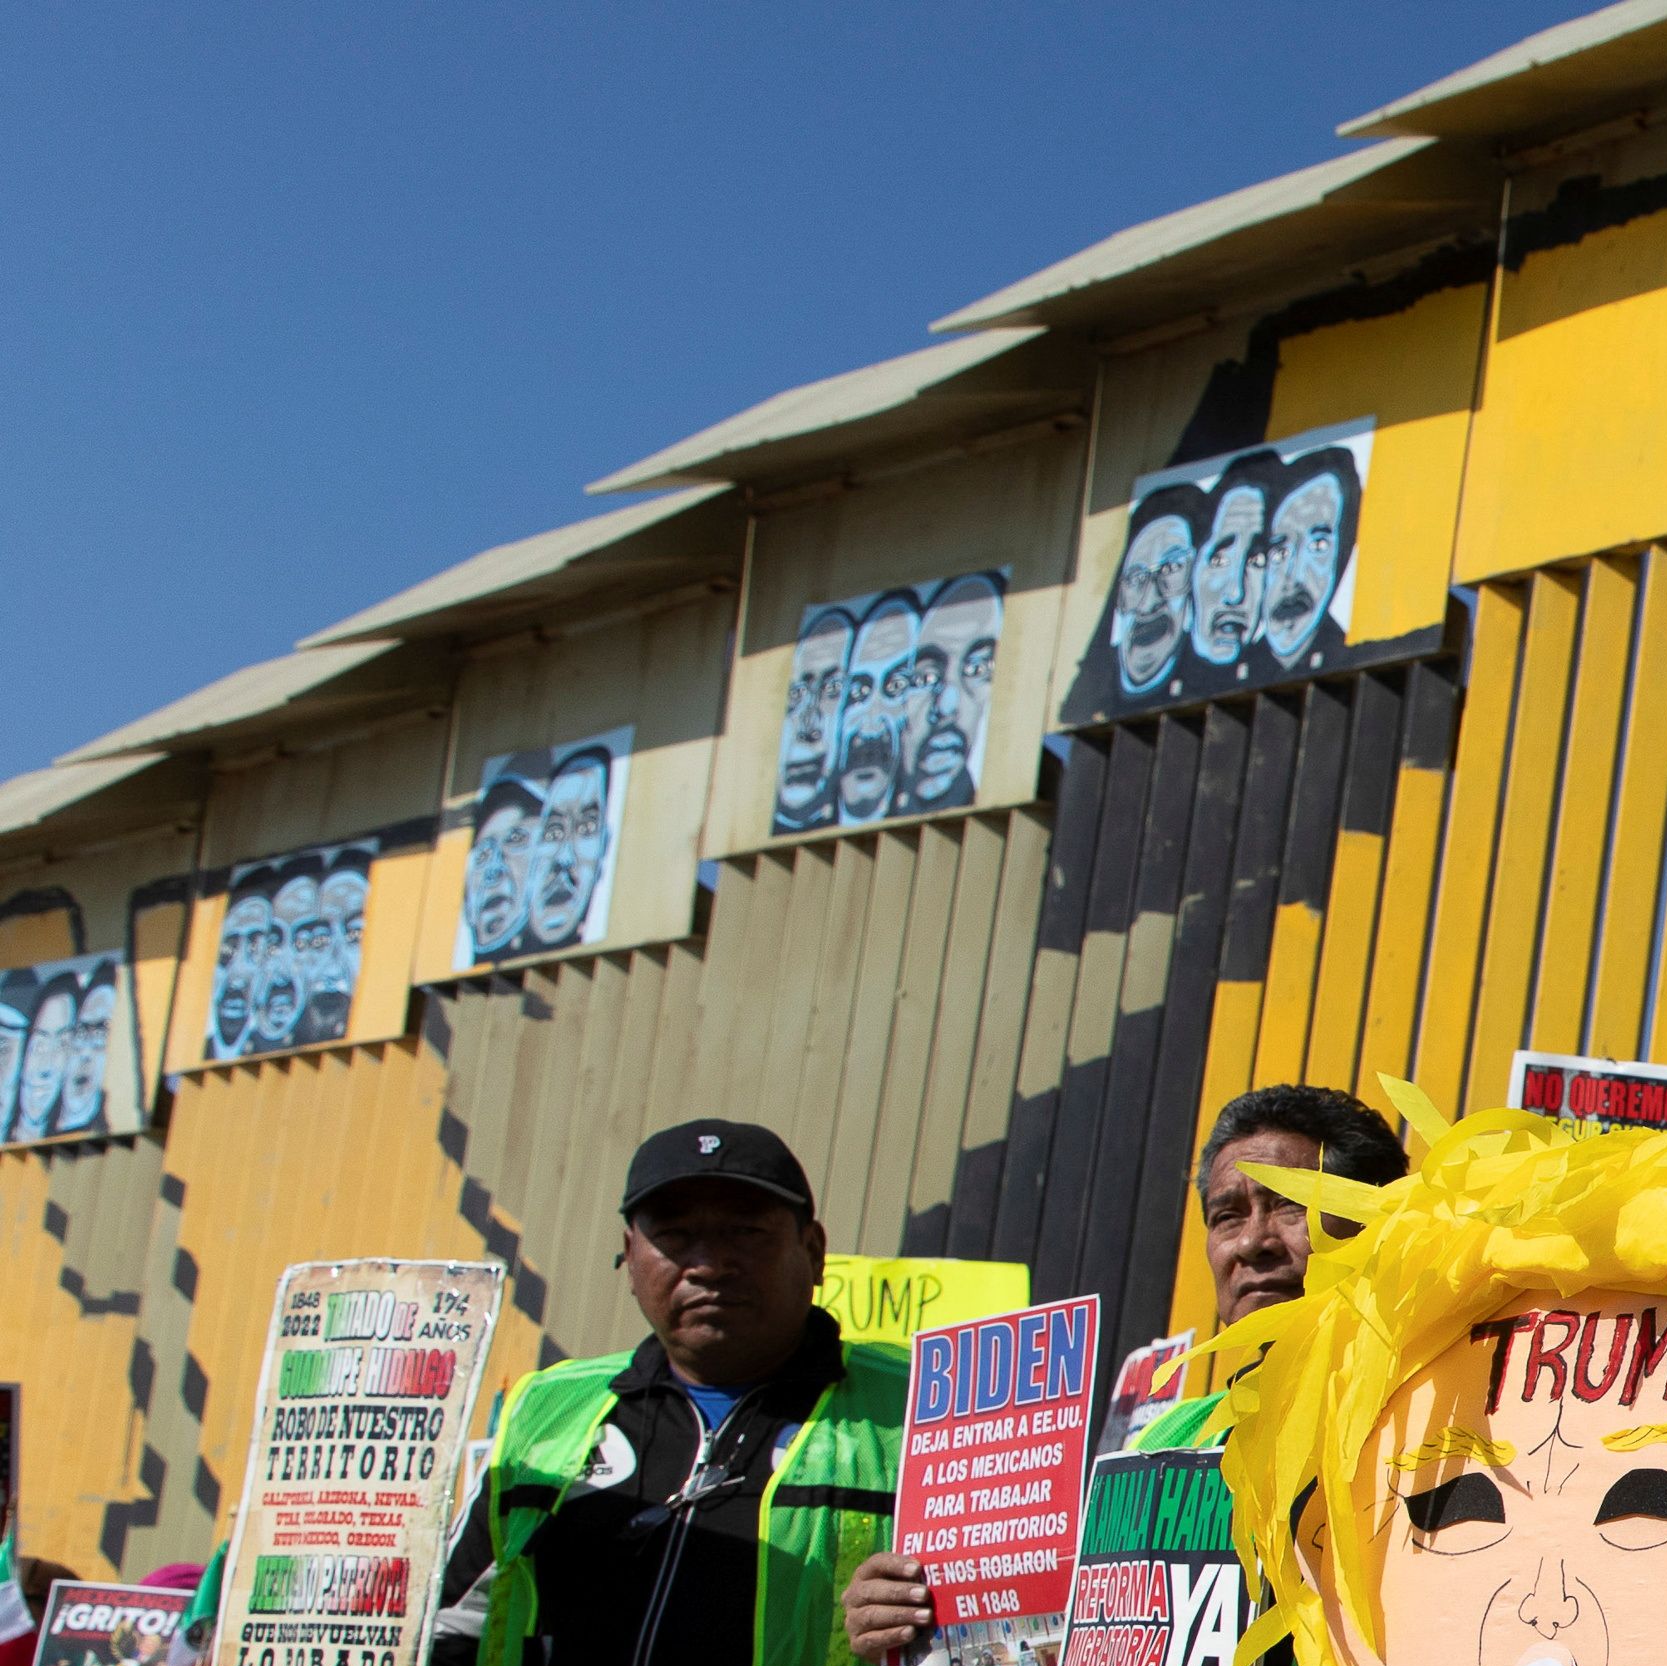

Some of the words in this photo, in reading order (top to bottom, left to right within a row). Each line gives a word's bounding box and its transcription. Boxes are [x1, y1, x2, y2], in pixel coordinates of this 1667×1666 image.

[1523, 1070, 1563, 1111] NO
[698, 1135, 721, 1154] P
[282, 1314, 321, 1337] 2022
[914, 1305, 1089, 1424] BIDEN
[339, 1406, 444, 1441] NUESTRO
[911, 1427, 949, 1455] DEJA
[953, 1415, 1014, 1449] ENTRAR
[1017, 1415, 1028, 1436] A
[1033, 1405, 1083, 1435] EE.UU.
[266, 1444, 437, 1482] TERRITORIO
[922, 1465, 933, 1486] A
[937, 1460, 968, 1484] LOS
[970, 1443, 1063, 1479] MEXICANOS
[924, 1493, 965, 1519] PARA
[970, 1479, 1052, 1512] TRABAJAR
[1083, 1468, 1156, 1555] KAMALA
[903, 1532, 924, 1555] EN
[926, 1527, 958, 1552] LOS
[962, 1512, 1068, 1547] TERRITORIOS
[943, 1558, 977, 1584] NOS
[980, 1548, 1057, 1581] ROBARON
[956, 1593, 979, 1618] EN
[982, 1589, 1020, 1614] 1848
[1074, 1560, 1169, 1623] REFORMA
[51, 1603, 182, 1636] ¡GRITO!
